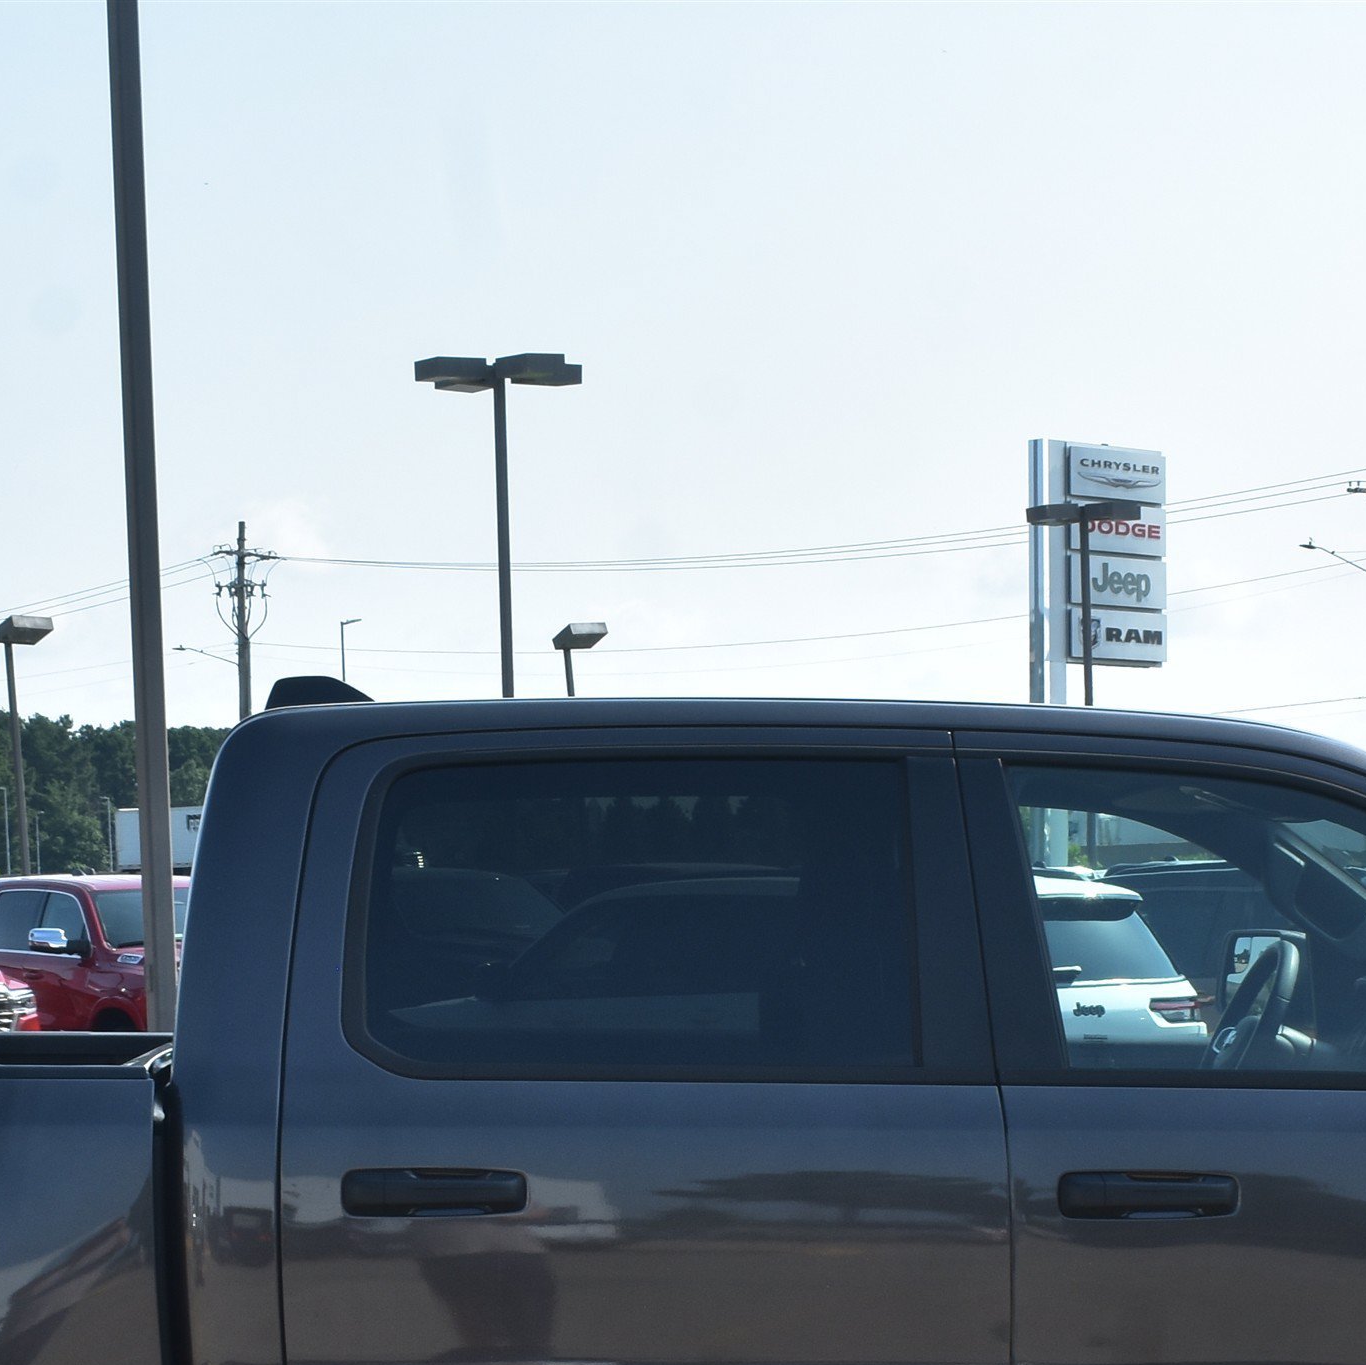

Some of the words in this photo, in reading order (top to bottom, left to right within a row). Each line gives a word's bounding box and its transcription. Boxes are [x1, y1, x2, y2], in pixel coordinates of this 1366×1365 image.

[1079, 457, 1160, 475] CHRYSLER
[1092, 562, 1152, 602] Jeep
[1105, 626, 1163, 646] RAM
[1072, 1001, 1106, 1018] Jeep
